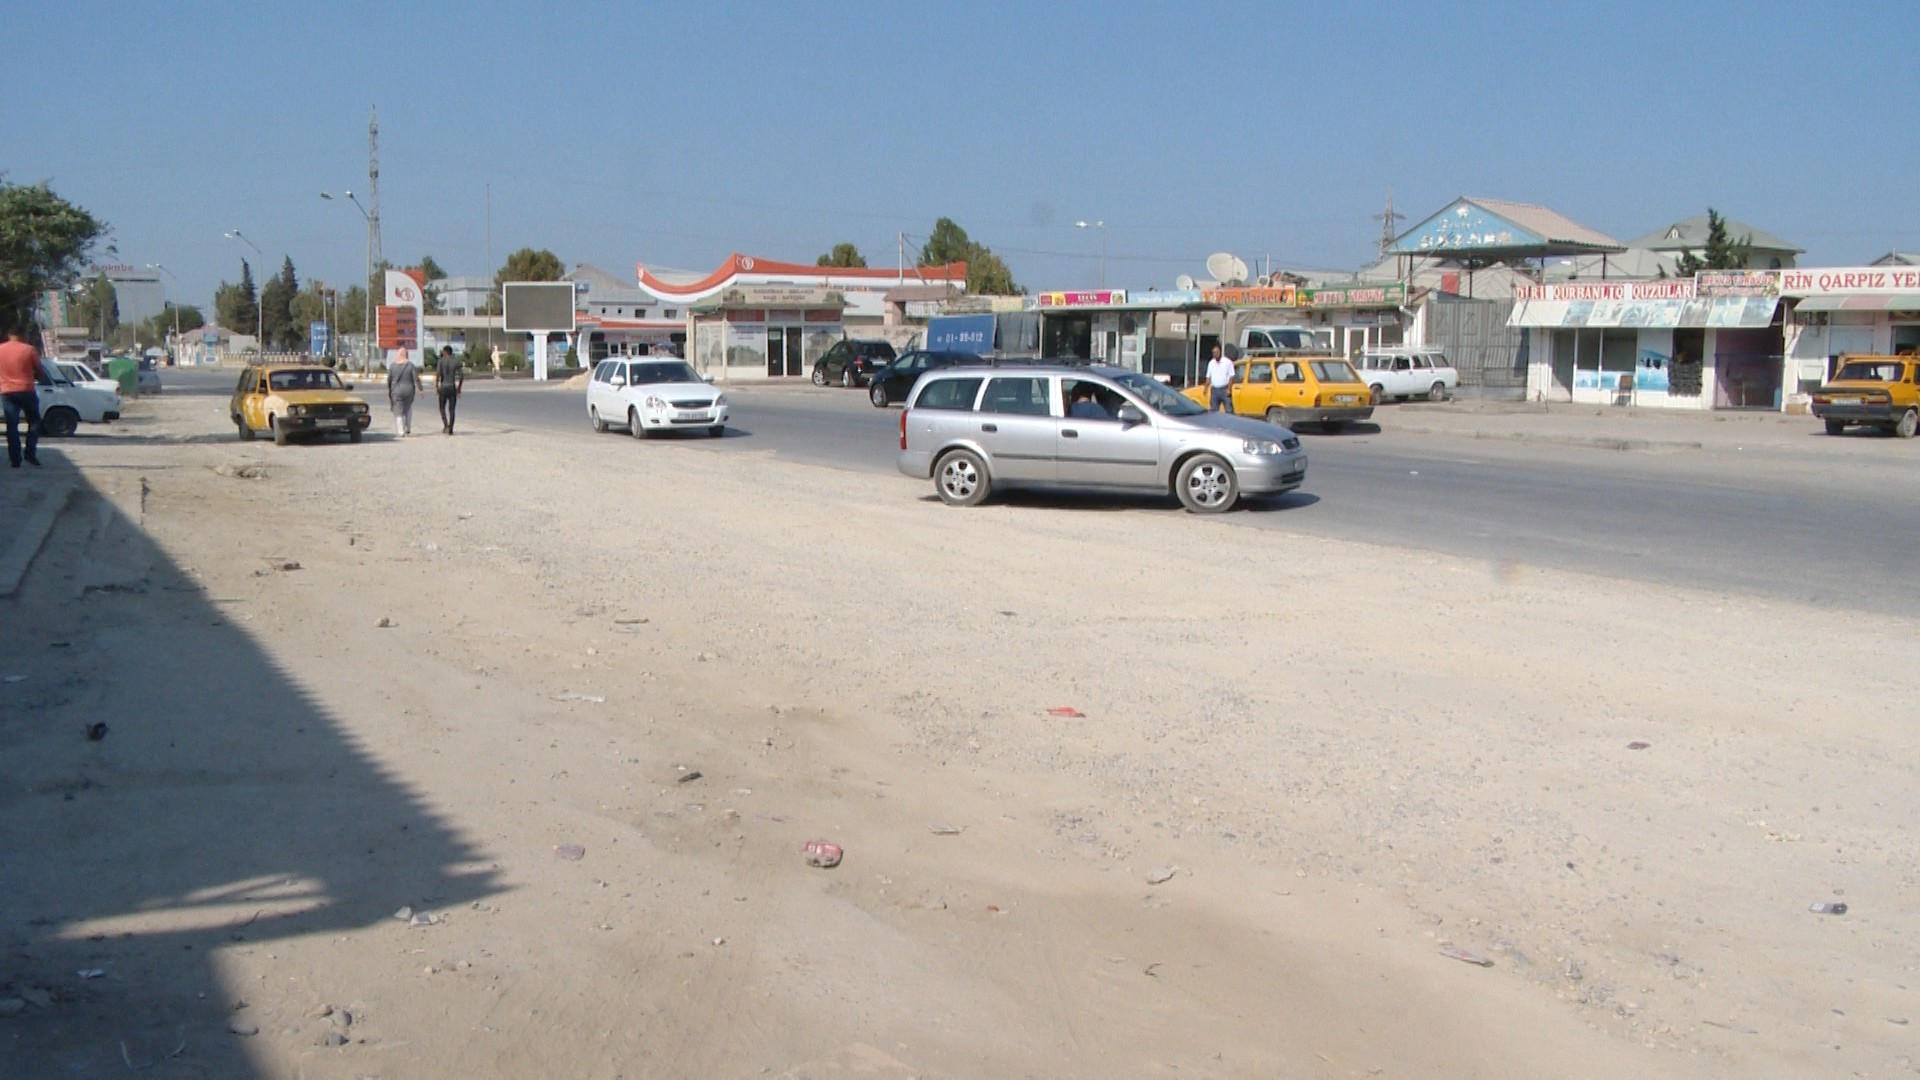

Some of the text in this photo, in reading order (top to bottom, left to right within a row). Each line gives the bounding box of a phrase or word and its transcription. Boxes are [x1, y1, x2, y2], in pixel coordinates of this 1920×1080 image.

[1818, 272, 1886, 291] QARPIZ
[1245, 290, 1279, 304] Market
[1553, 285, 1624, 301] QURBANLIQ
[1633, 283, 1692, 300] QUZULAR
